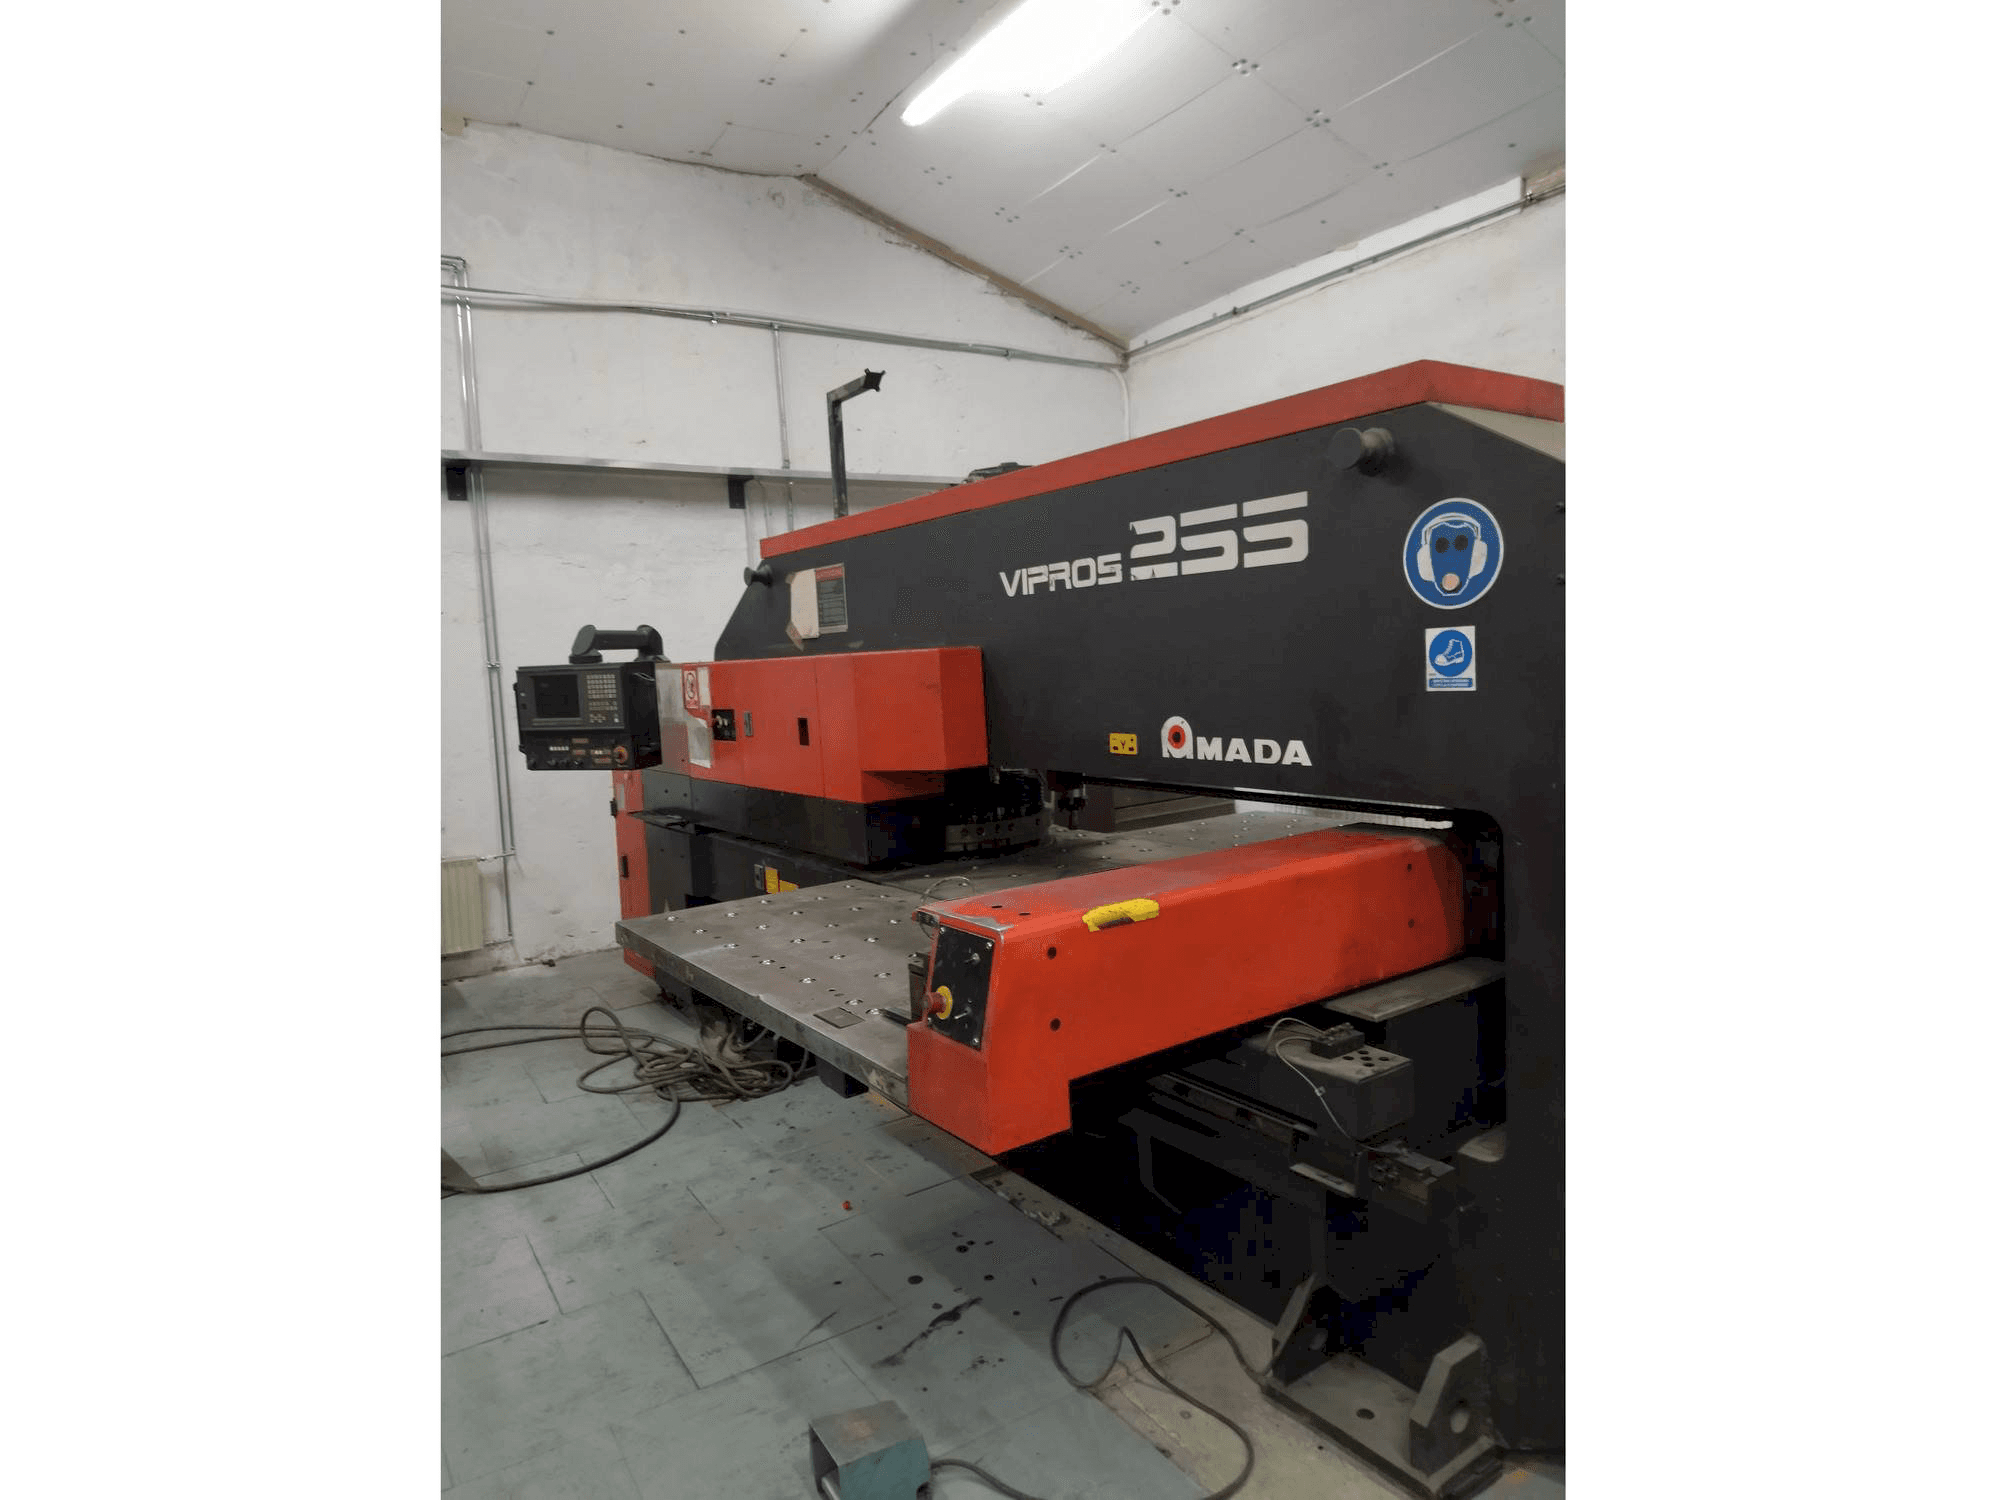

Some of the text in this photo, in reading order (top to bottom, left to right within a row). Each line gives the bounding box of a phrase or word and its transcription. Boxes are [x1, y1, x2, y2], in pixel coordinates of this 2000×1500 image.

[999, 491, 1309, 597] VIPROS 255
[1161, 715, 1313, 766] AMADA
